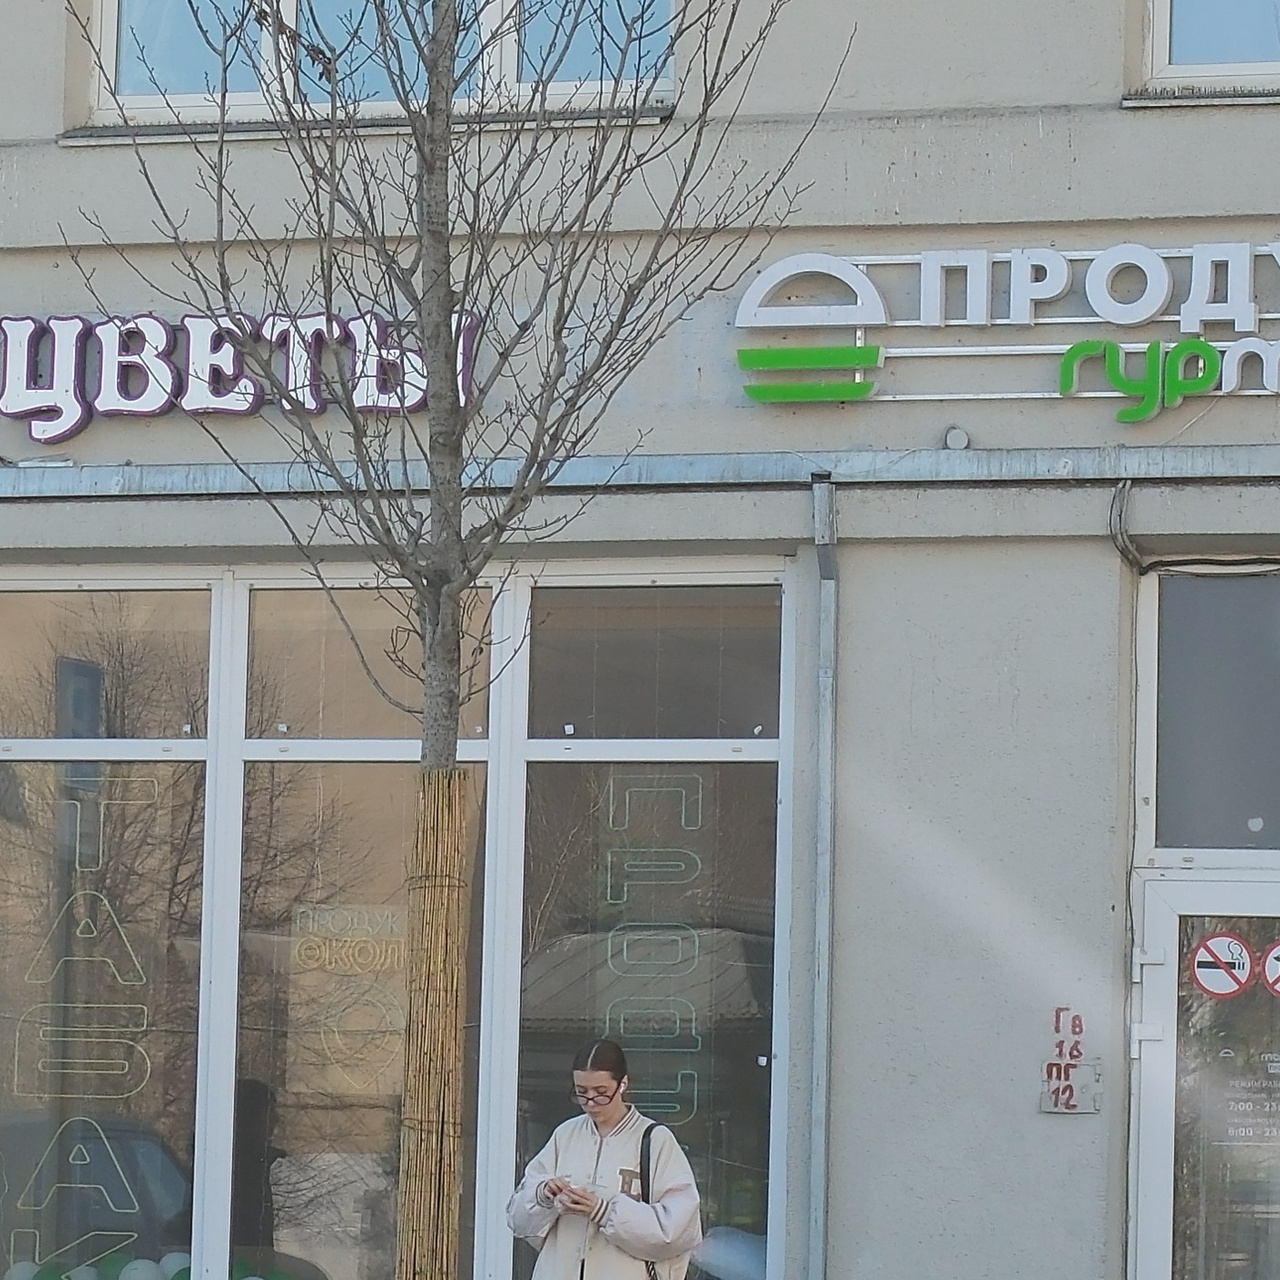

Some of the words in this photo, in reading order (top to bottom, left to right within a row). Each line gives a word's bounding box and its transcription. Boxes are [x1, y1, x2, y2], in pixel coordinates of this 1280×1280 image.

[0, 313, 480, 445] ЦВЕТЫ
[297, 909, 403, 934] ПРОДУК
[296, 938, 405, 972] ОКОЛ
[602, 774, 702, 1150] ПРОДУ
[1055, 1039, 1083, 1060] 16
[1051, 1083, 1078, 1110] 12
